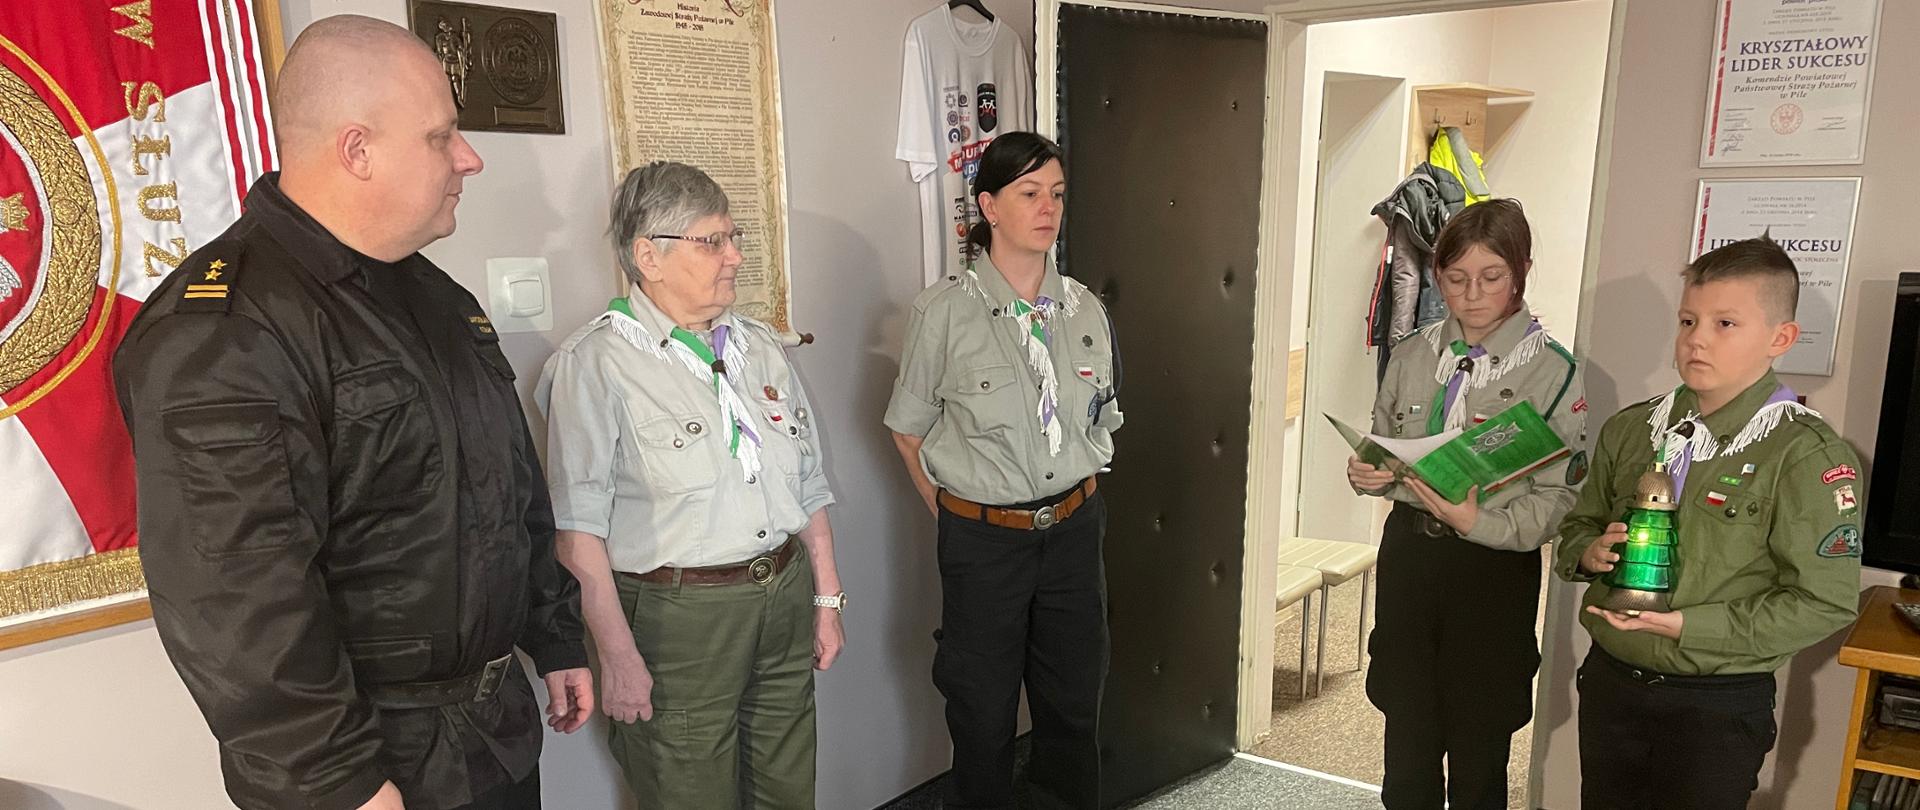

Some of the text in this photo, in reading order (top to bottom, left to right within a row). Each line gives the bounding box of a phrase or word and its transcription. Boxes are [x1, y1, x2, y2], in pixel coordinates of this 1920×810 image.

[111, 0, 155, 49] W
[1740, 36, 1869, 55] KRYSZTAŁOWY
[1731, 53, 1867, 72] LIDER SUKCESU
[1746, 72, 1847, 84] Komendzie Powiatowej
[1734, 80, 1858, 93] Państwowej Straży Pożarnej
[1790, 90, 1807, 98] Pile
